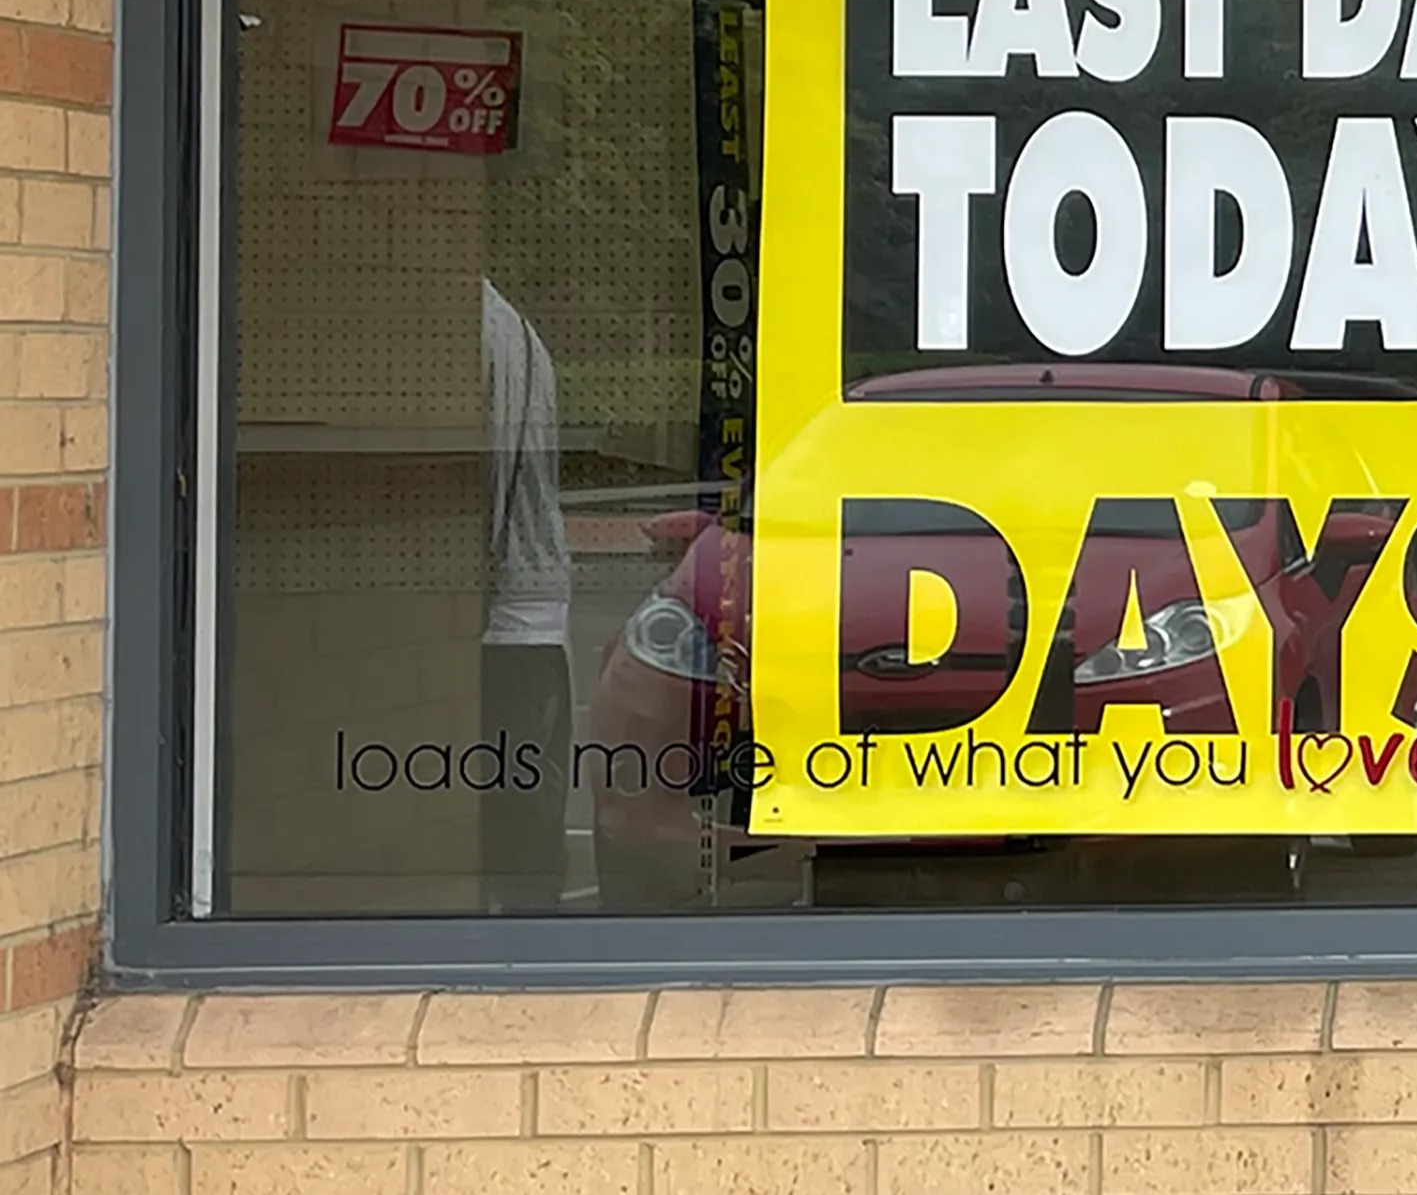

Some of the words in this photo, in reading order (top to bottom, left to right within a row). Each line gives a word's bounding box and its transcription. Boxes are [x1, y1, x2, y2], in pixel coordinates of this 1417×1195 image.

[718, 9, 743, 163] LEAST
[449, 107, 503, 136] OFF
[709, 334, 728, 399] OFF
[334, 729, 542, 794] loads
[570, 738, 777, 794] more
[803, 729, 880, 791] of
[902, 729, 1090, 791] what
[1112, 736, 1249, 802] you
